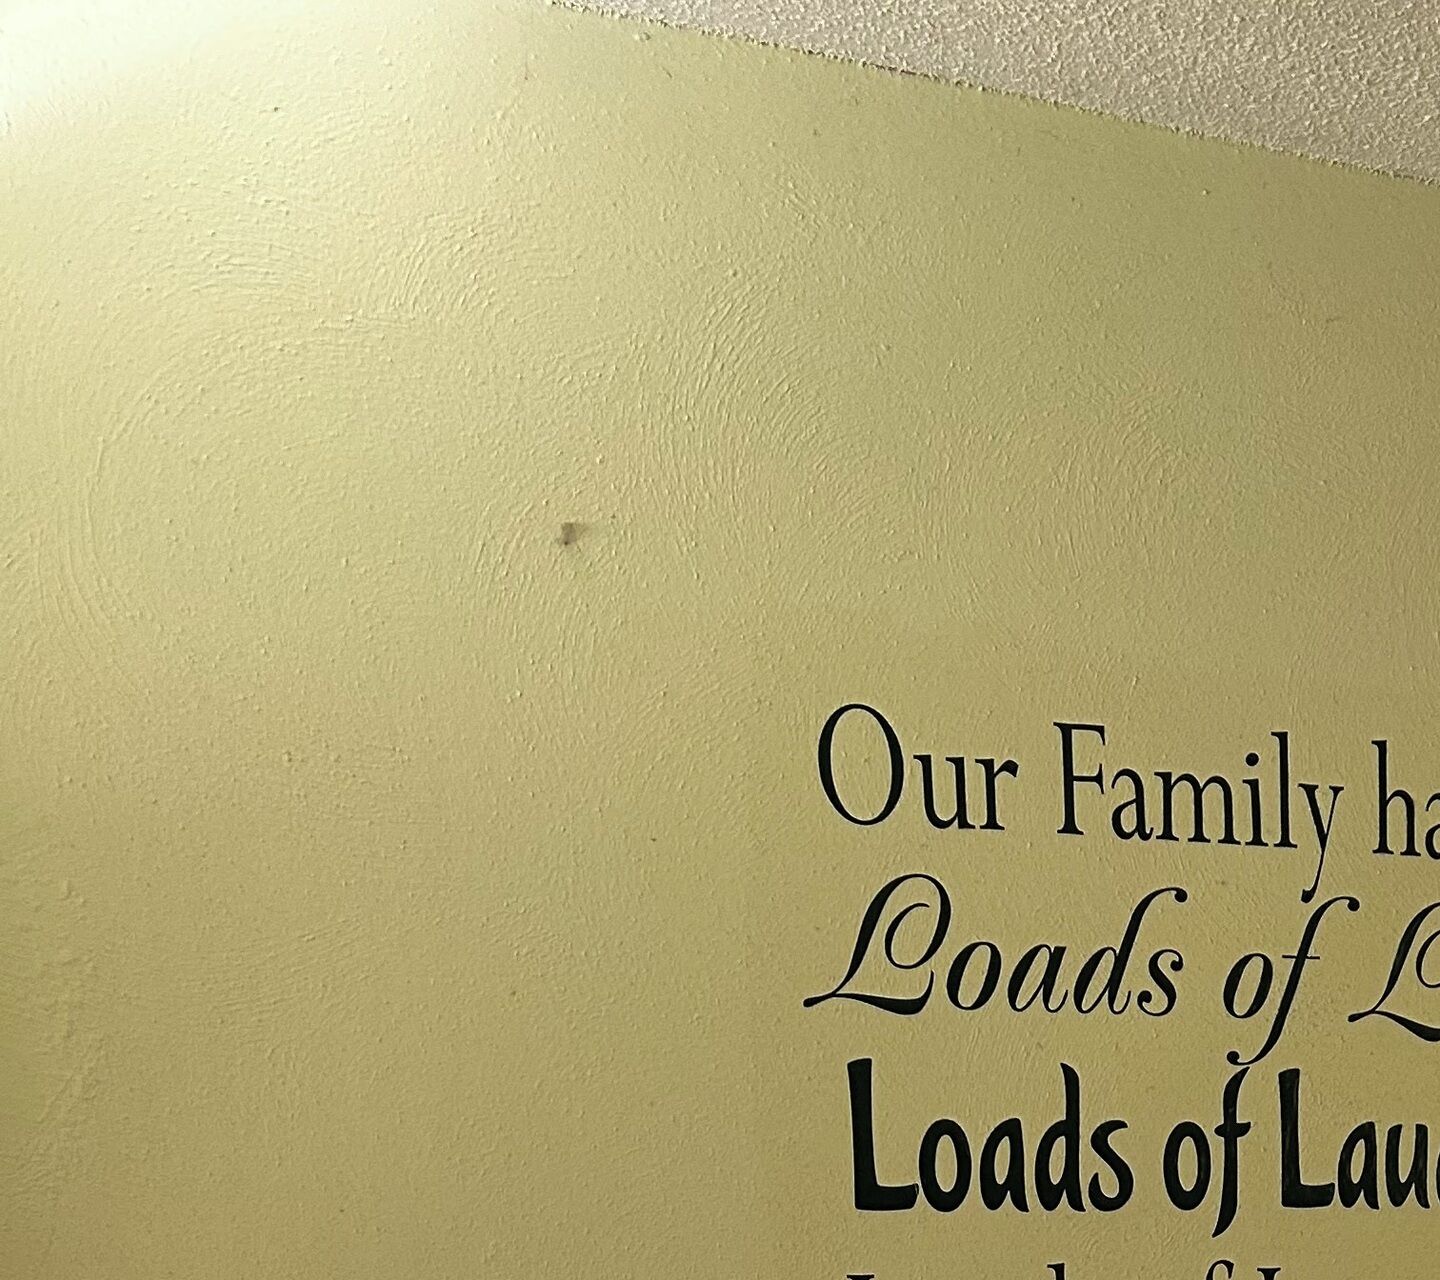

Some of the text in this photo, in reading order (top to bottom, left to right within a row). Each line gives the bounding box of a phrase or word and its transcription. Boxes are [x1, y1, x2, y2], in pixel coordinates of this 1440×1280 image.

[817, 703, 1019, 831] Our
[1052, 721, 1345, 904] Family
[802, 873, 1188, 1017] Loads
[1222, 895, 1361, 1066] of
[846, 1057, 1135, 1213] Loads
[1162, 1066, 1252, 1239] of
